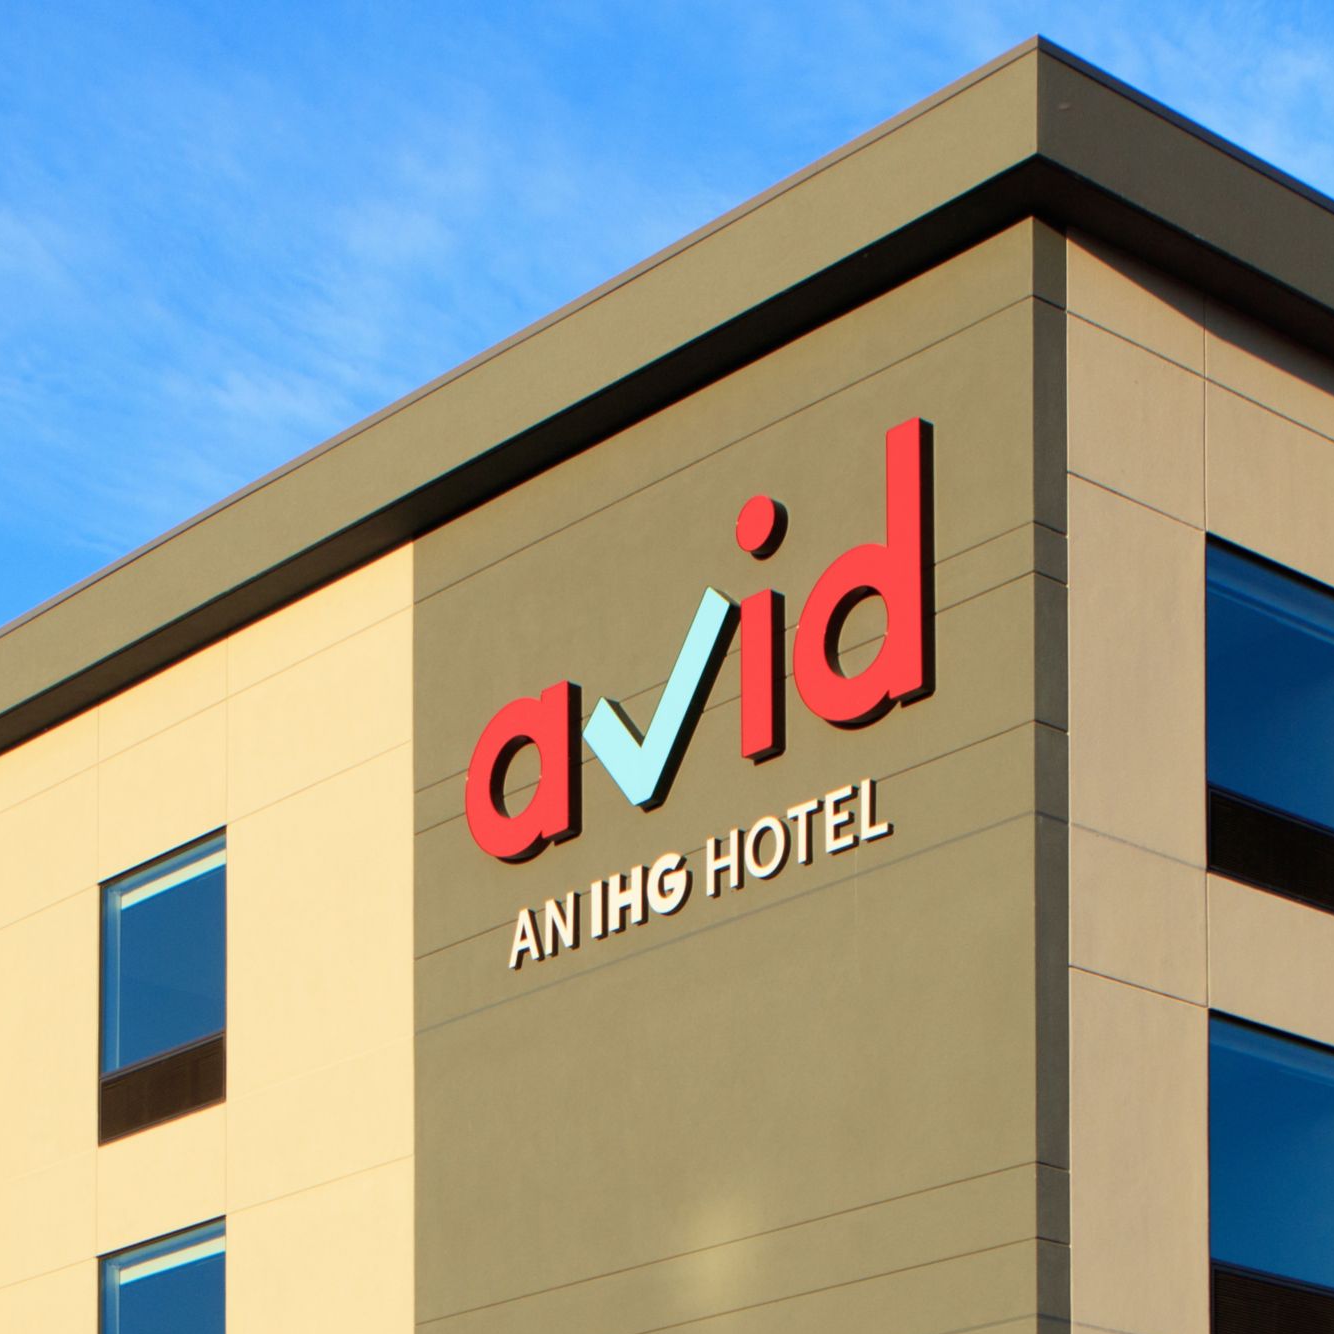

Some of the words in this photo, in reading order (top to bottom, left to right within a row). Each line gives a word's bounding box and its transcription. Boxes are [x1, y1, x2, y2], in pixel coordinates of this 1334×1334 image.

[465, 416, 930, 860] avid
[508, 890, 579, 969] AN
[590, 852, 691, 940] IHG
[705, 778, 893, 898] HOTEL
